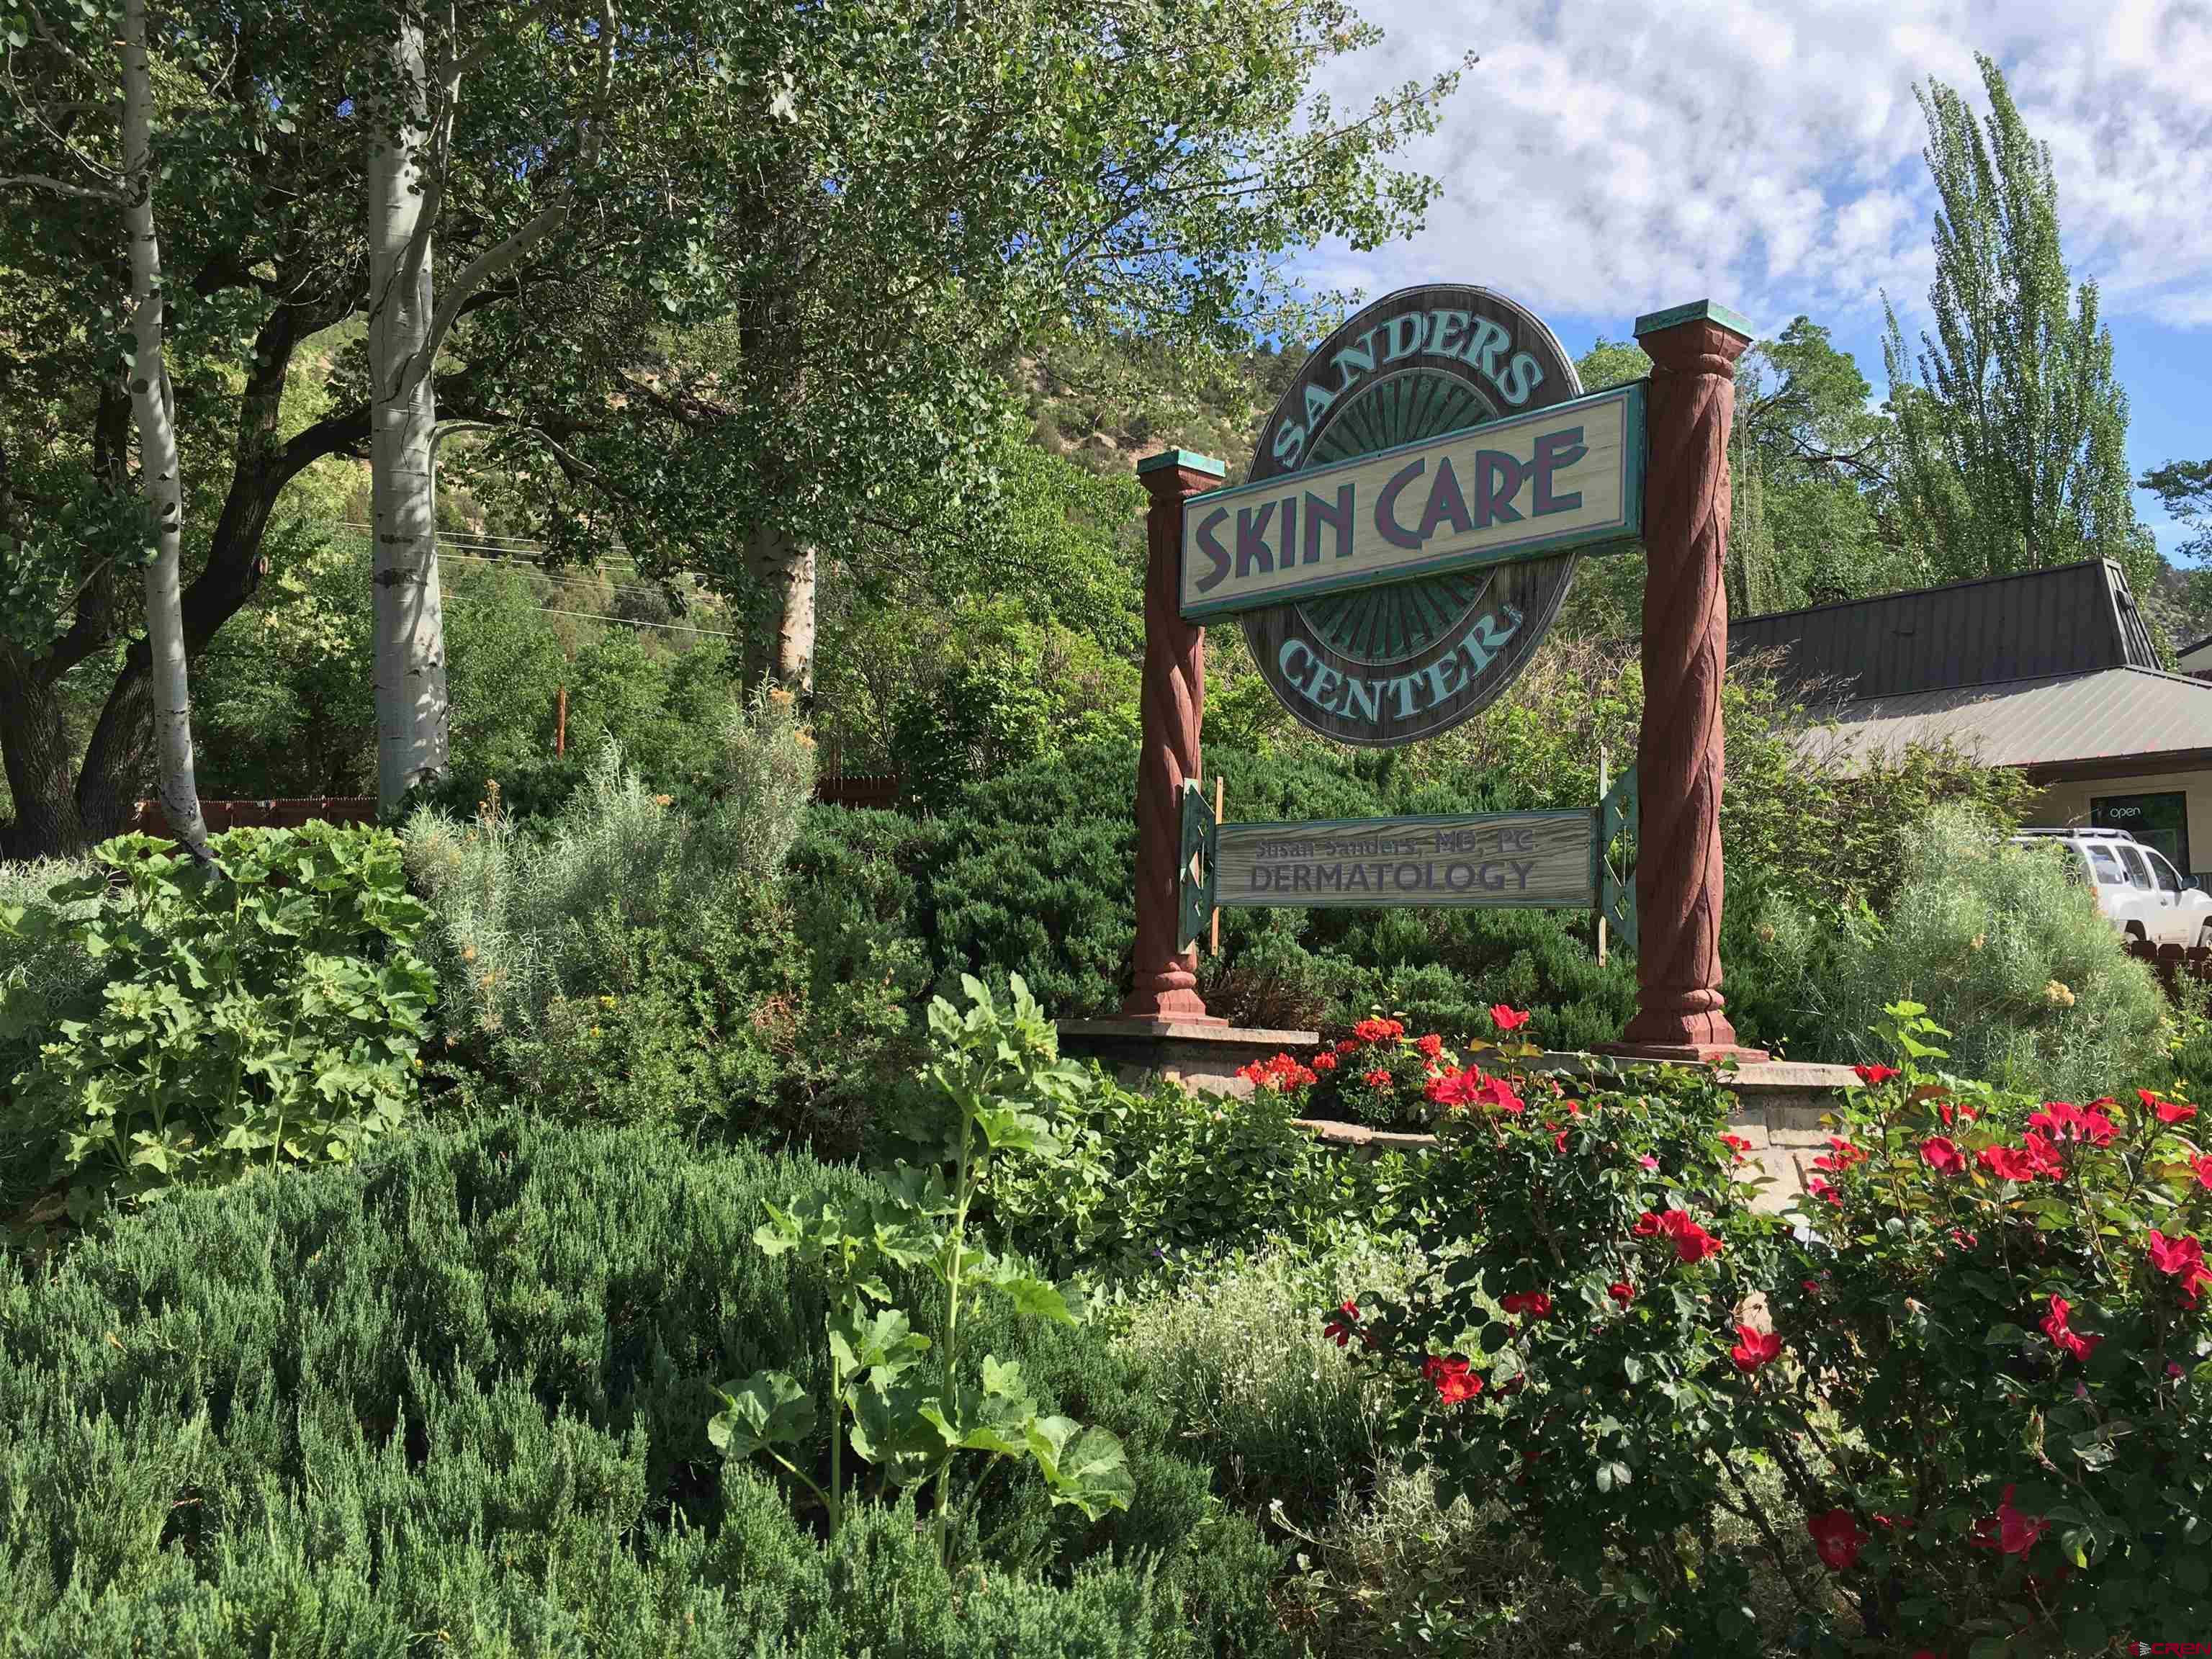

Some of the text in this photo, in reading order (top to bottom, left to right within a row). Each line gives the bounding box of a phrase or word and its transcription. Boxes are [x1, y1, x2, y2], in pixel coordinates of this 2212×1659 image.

[1272, 310, 1545, 471] SANDERS
[1195, 426, 1589, 593] SKIN CARE
[1278, 603, 1522, 723] CENTER
[1250, 863, 1535, 891] DERMATOLOGY
[1255, 840, 1314, 858] Susan
